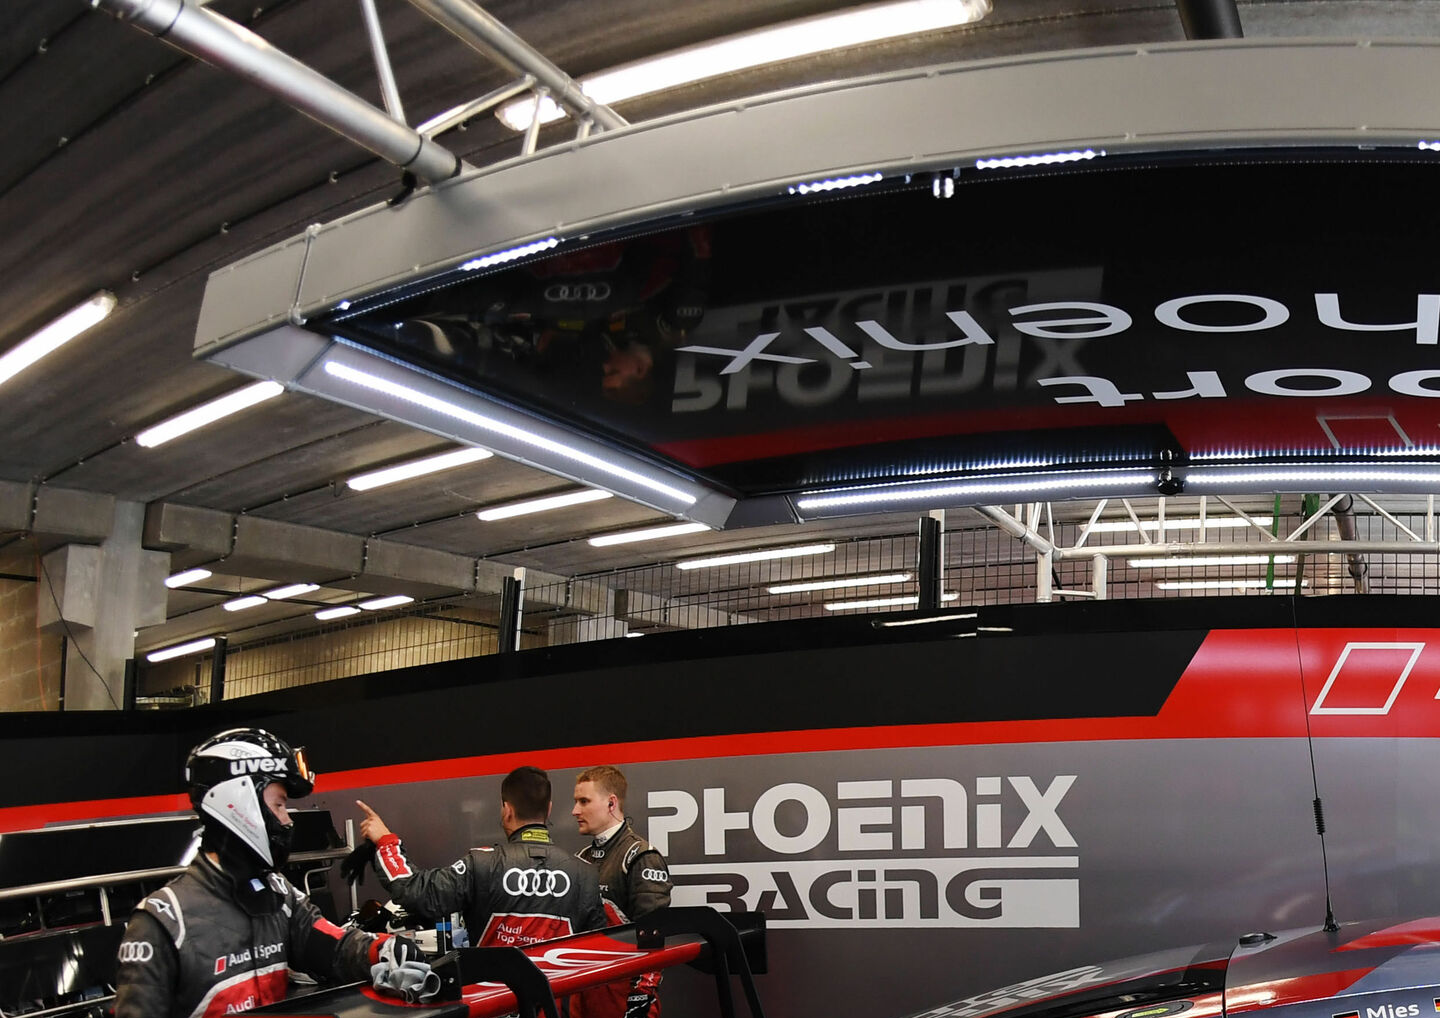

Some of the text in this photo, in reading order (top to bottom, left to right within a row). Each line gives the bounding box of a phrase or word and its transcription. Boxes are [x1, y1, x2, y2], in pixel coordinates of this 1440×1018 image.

[230, 757, 289, 776] uvex
[647, 775, 1079, 856] PHOENIX
[496, 930, 515, 944] Top
[497, 922, 523, 935] Audi
[227, 942, 284, 967] Audi Spor
[226, 995, 255, 1015] Audi
